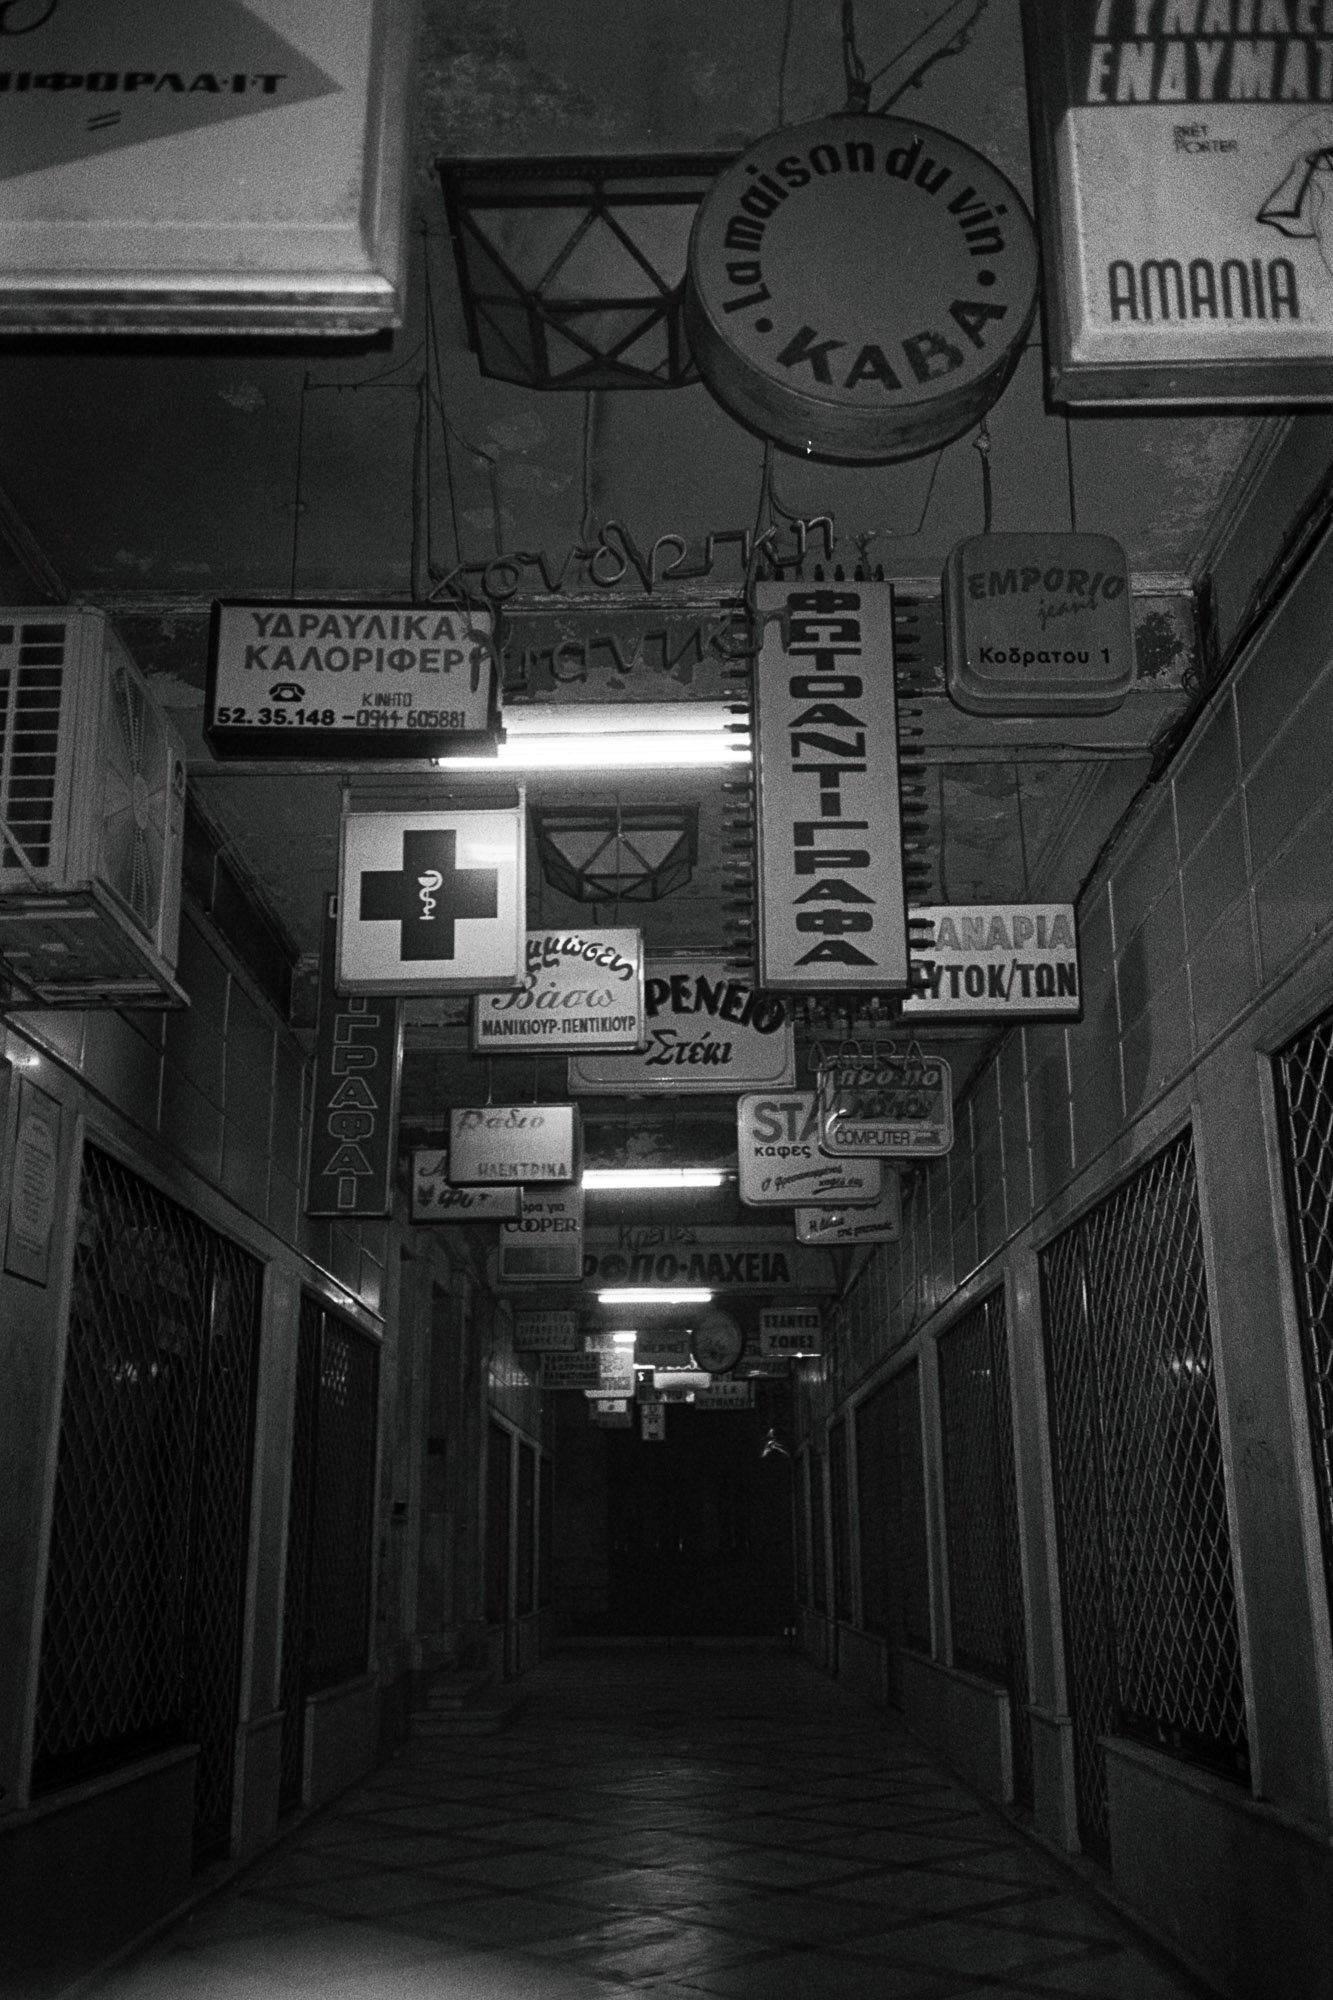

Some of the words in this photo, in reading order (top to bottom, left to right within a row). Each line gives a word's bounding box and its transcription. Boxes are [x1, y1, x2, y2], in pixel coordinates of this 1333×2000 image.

[724, 141, 875, 253] maison
[885, 137, 953, 196] du
[947, 186, 1009, 256] vin
[1108, 257, 1300, 321] AMANIA
[776, 300, 1008, 390] ΚΑΒΑ
[967, 567, 1125, 600] EMPORIO
[251, 612, 456, 641] ΥΔΡΑΥΛΙΚΑ
[243, 645, 465, 673] ΚΑΛΟΡΙΦΕΡ
[979, 647, 1090, 668] Κοδρατου
[1101, 648, 1110, 664] 1
[361, 692, 412, 707] ΚΙΝΗΤΟ
[786, 589, 879, 967] ΦΩΤΟΑΝΤΙΓΡΑΦΑ
[916, 914, 1076, 951] ΑΝΑΡΙΑ
[491, 972, 617, 1011] Βάσω
[645, 1028, 734, 1066] Στέκι
[834, 1130, 910, 1145] COMPUTER
[477, 1162, 568, 1177] ΗΛΕΚΤΡΙΚΑ
[504, 1217, 578, 1233] COOPER
[769, 1336, 815, 1349] ΖΩΝΕΣ
